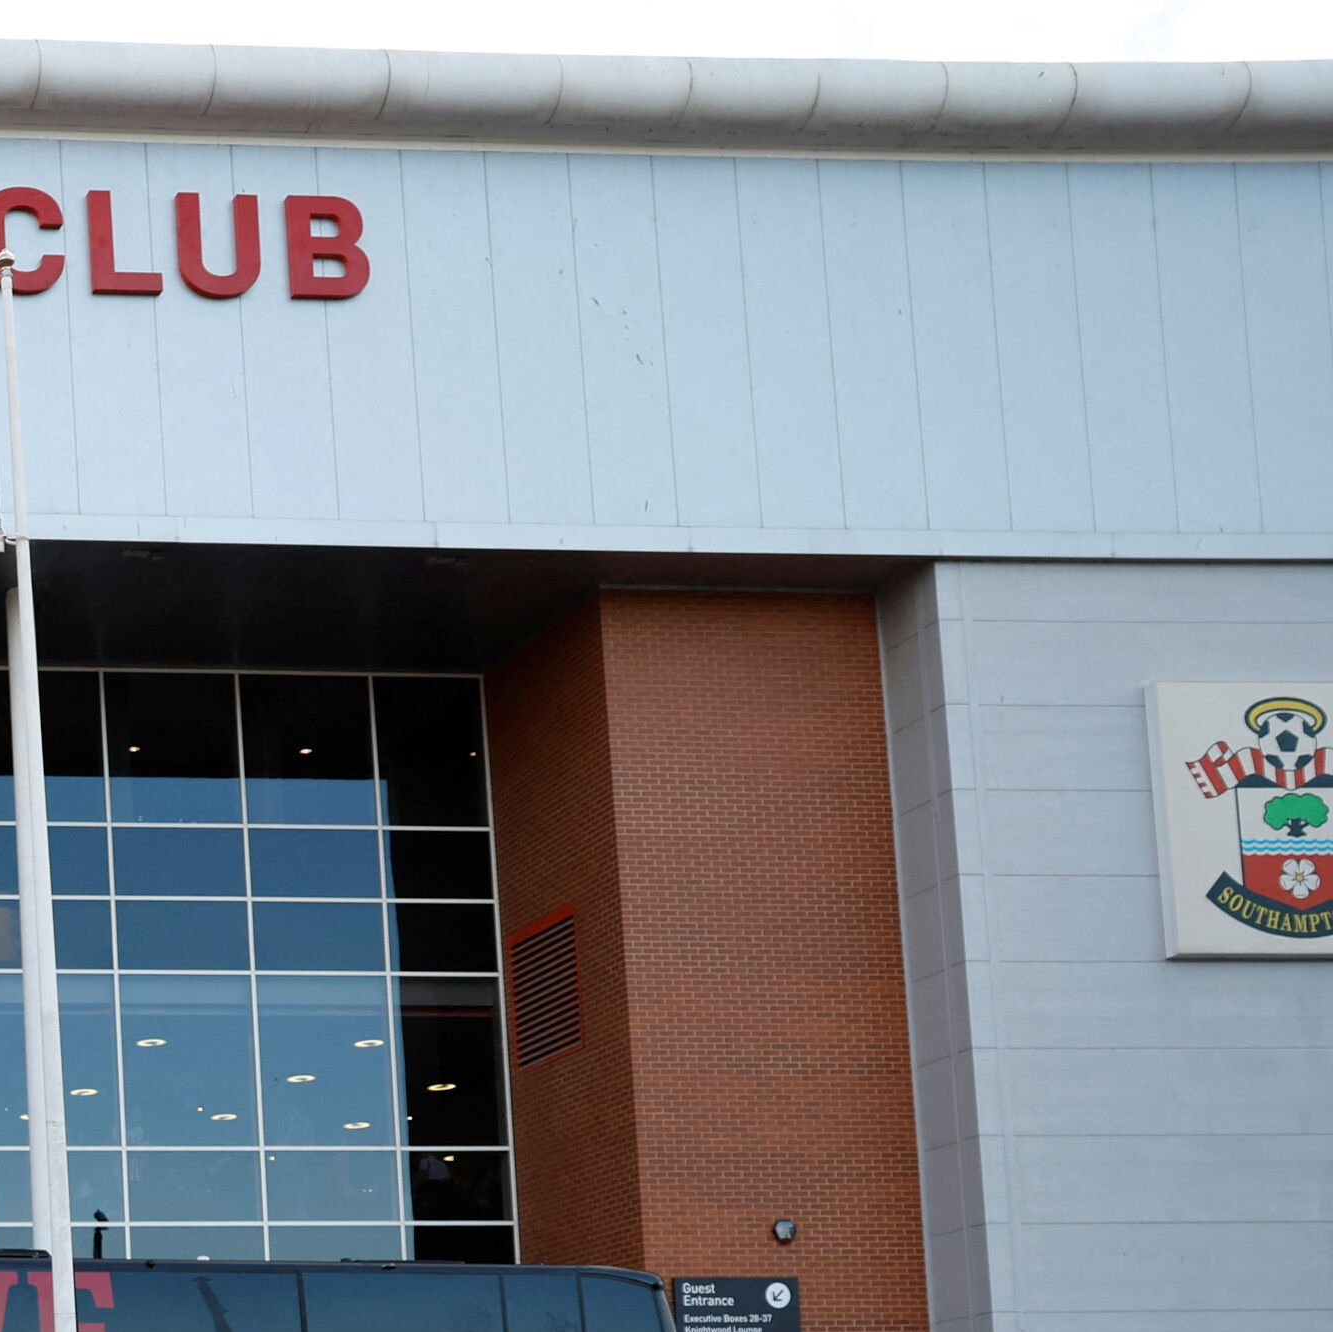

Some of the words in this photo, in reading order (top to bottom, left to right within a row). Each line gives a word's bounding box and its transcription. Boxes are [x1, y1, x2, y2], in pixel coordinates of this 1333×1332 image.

[1217, 886, 1333, 933] SOUTHAMPT
[683, 1283, 715, 1294] Guest
[683, 1295, 734, 1306] Entrance
[685, 1314, 722, 1323] Executive
[723, 1315, 747, 1323] Boxes
